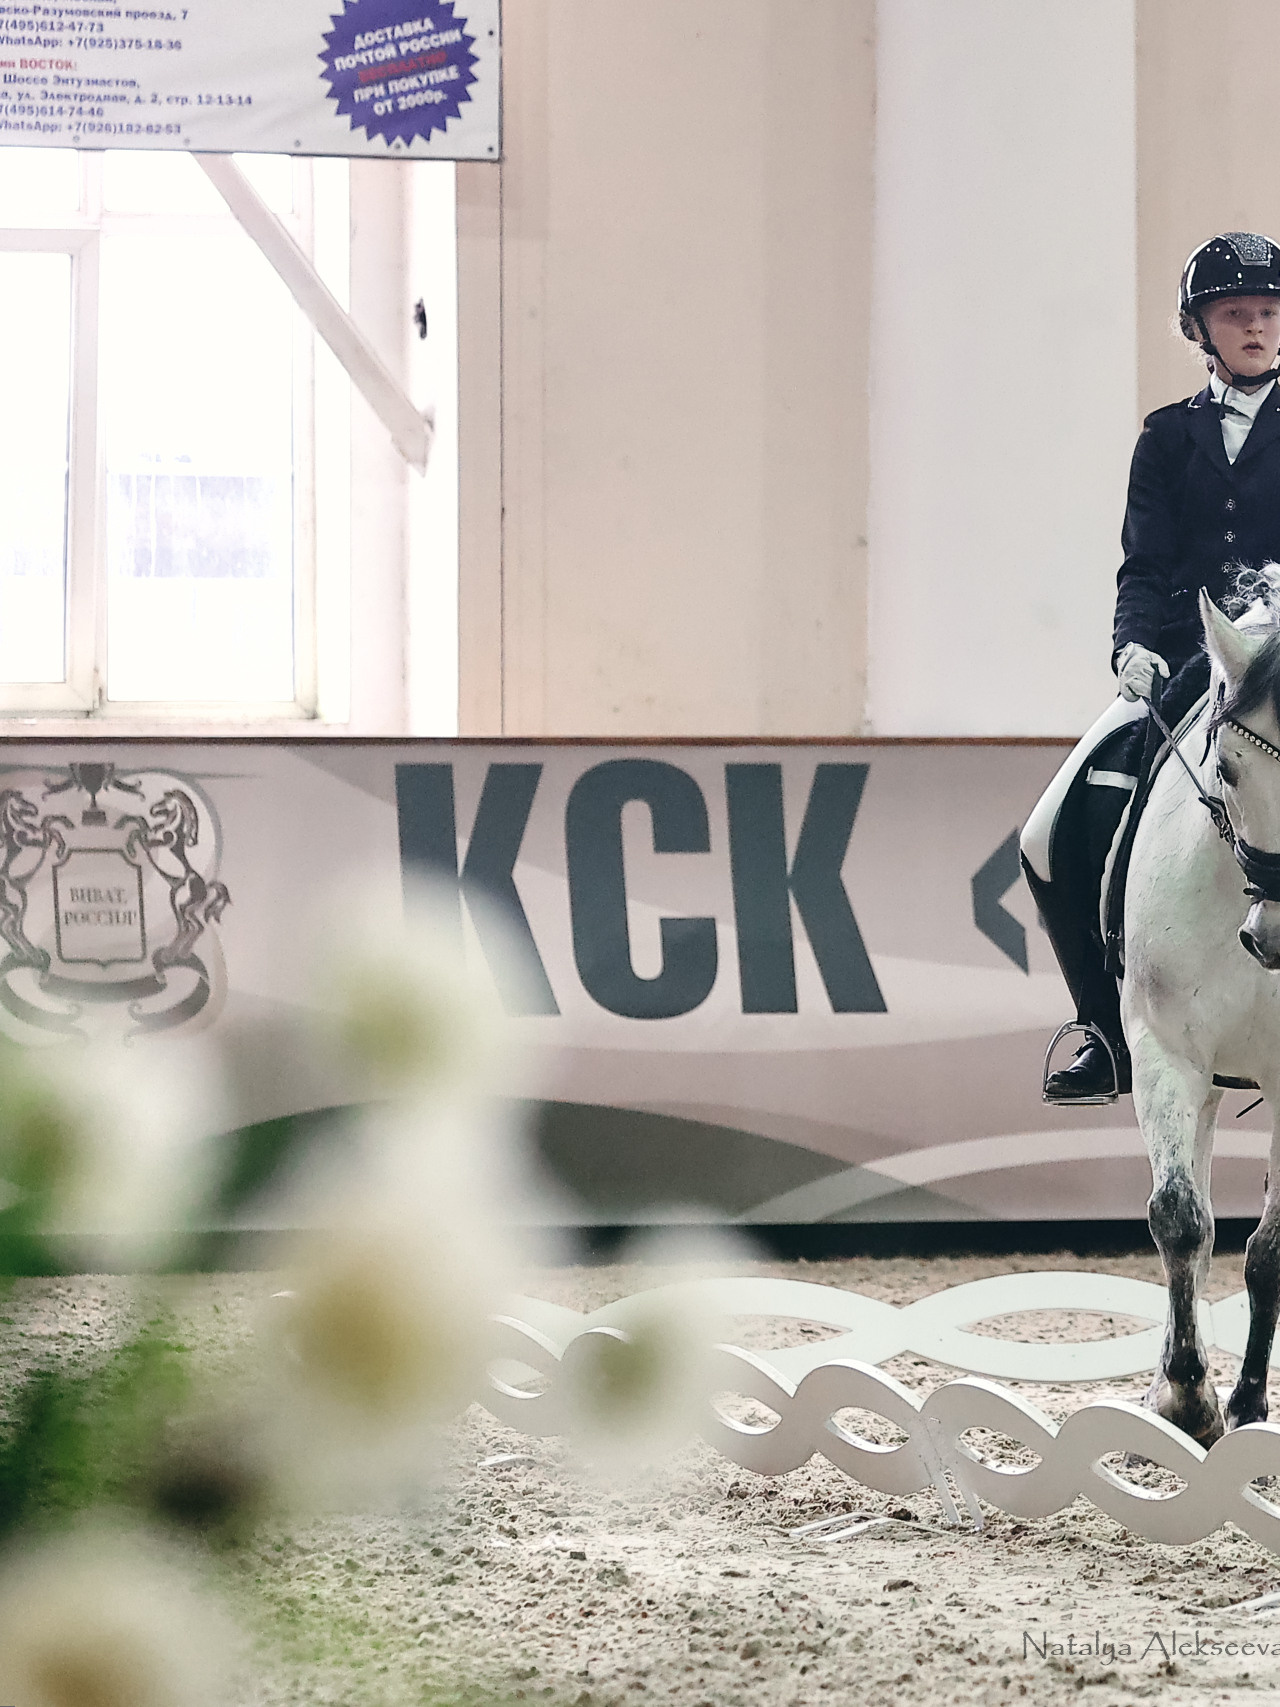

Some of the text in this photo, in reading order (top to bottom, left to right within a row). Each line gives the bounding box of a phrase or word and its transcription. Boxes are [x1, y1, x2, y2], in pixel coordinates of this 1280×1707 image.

[181, 9, 188, 20] 7
[334, 28, 462, 71] ПОЧТОЙ РОССИИ
[354, 17, 434, 50] ДОСТАВКА
[3, 73, 140, 89] Шоссе Энтузиастов,
[353, 64, 459, 103] ПРИ ПОКУПКЕ
[373, 99, 393, 116] ОТ
[395, 758, 888, 1019] КСК
